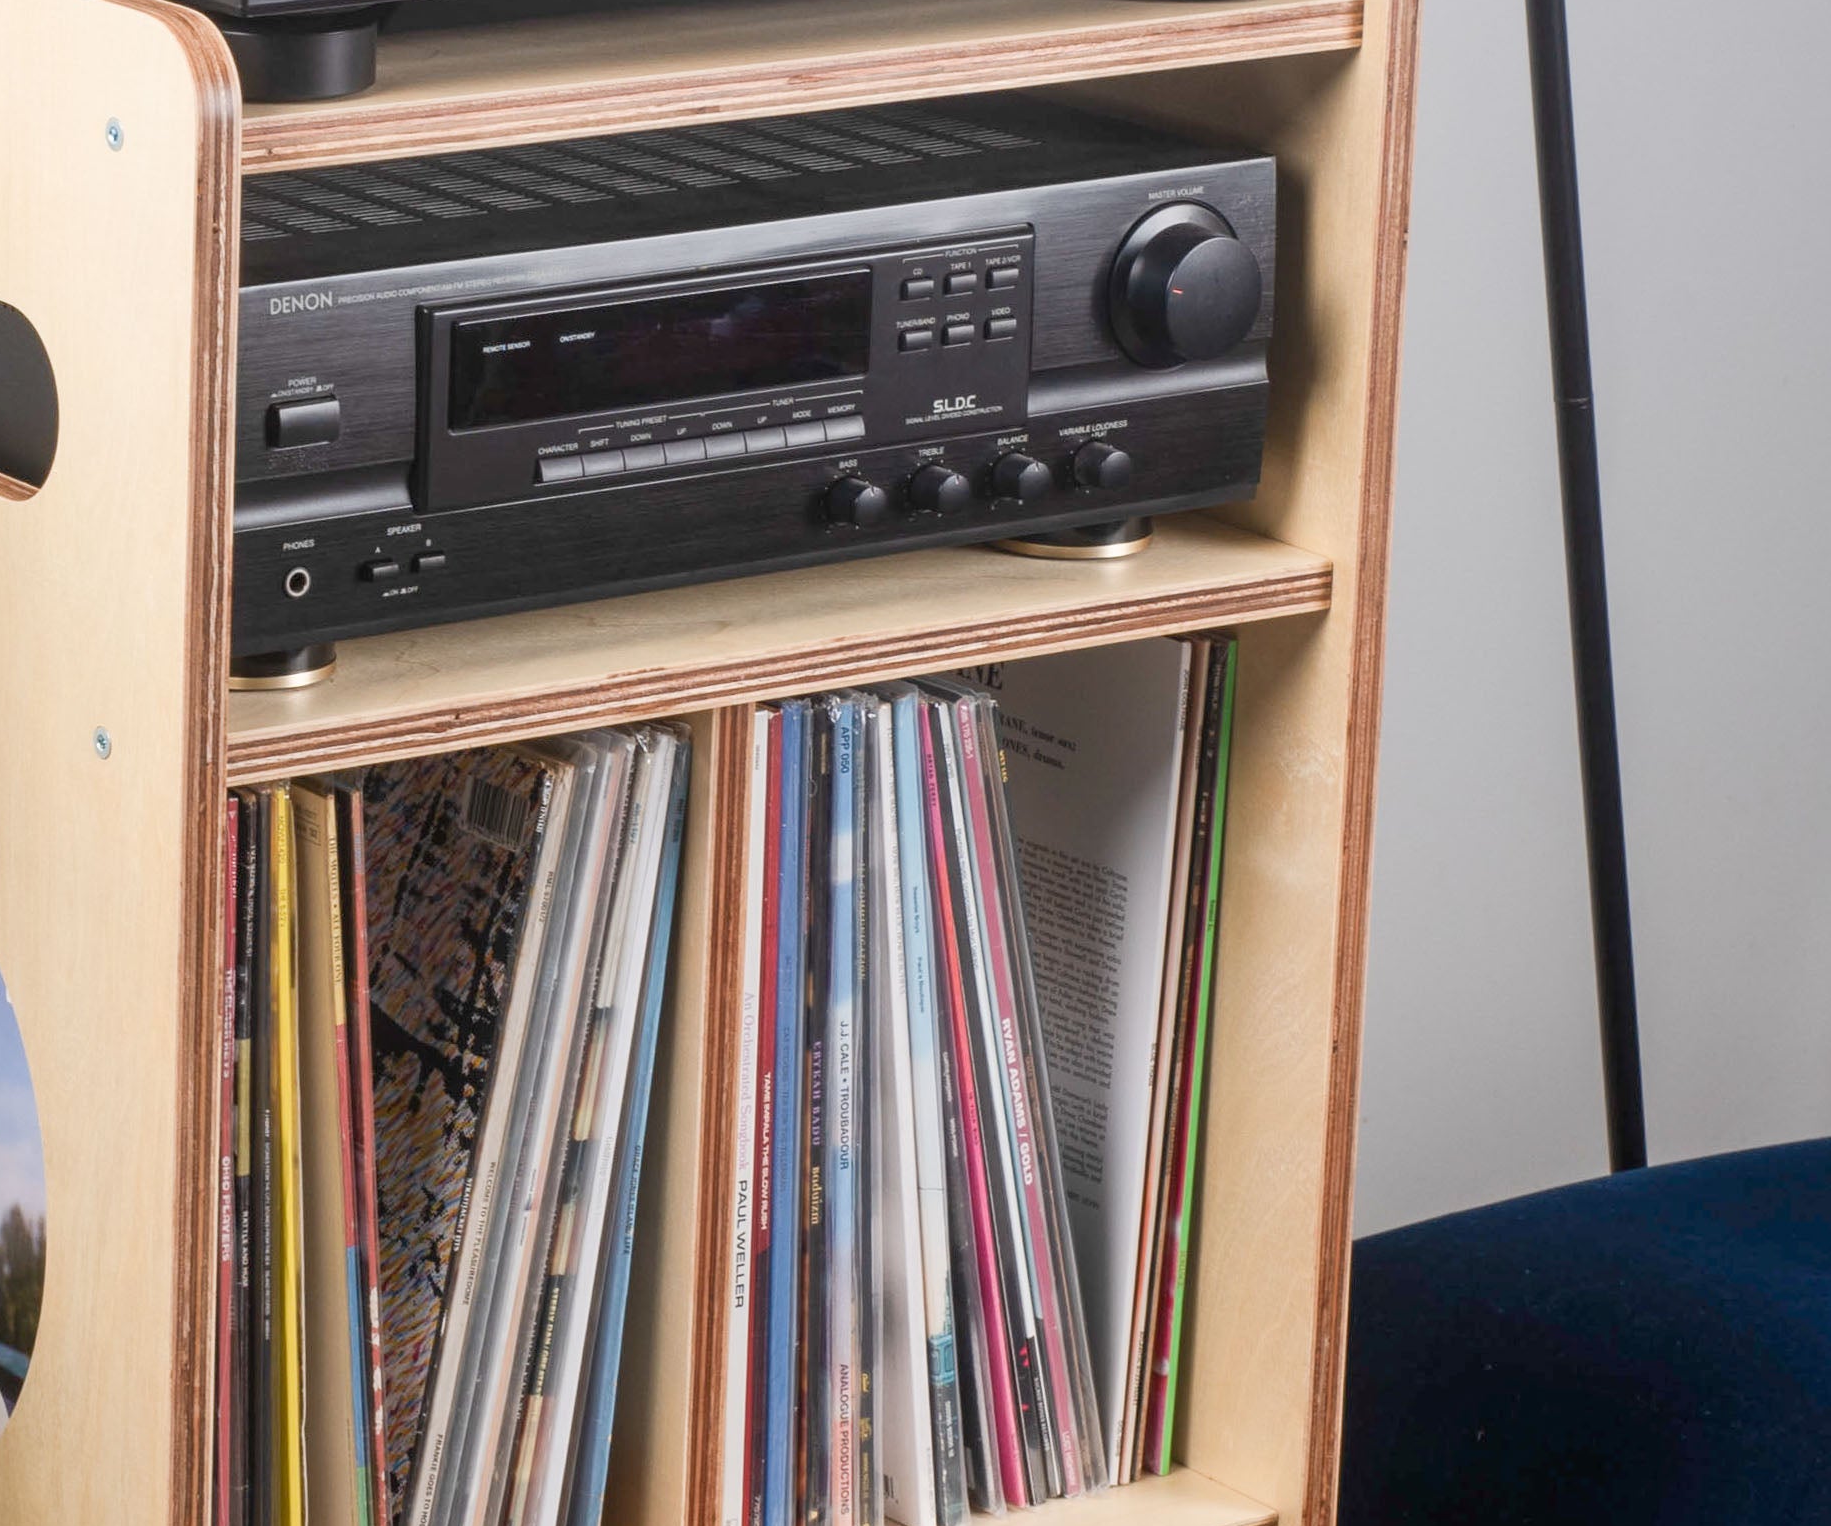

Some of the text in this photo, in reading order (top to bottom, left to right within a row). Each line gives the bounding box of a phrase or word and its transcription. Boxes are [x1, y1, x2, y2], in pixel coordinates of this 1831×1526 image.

[1148, 185, 1205, 200] MASTER VOLUME
[945, 247, 977, 258] FUNCTION
[950, 262, 967, 271] TAPE
[985, 257, 1001, 266] TAPE
[913, 267, 923, 276] CD
[270, 291, 333, 316] DENON
[946, 312, 970, 322] PHONO
[991, 306, 1011, 316] VIDEO
[482, 340, 531, 354] REMOTE SENSOR
[288, 376, 317, 388] POWER
[772, 396, 795, 408] TUNER
[827, 401, 856, 414] MEMORY
[757, 415, 768, 425] UP
[792, 408, 812, 420] MODE
[615, 414, 667, 429] TUNING PRESET
[712, 421, 734, 431] DOWN
[1058, 419, 1128, 438] VARIABLE LOUDNESS
[630, 431, 652, 443] DOWN
[677, 426, 687, 436] UP
[589, 437, 610, 449] SHIFT
[997, 433, 1029, 446] BALANCE
[538, 442, 580, 456] CHARACTER
[919, 445, 945, 457] TREBLE
[838, 458, 857, 470] BASS
[386, 523, 422, 536] SPEAKER
[282, 538, 315, 551] PHONES
[374, 546, 381, 554] A
[840, 726, 850, 774] APP 050
[998, 749, 1009, 783] WET LEG
[329, 836, 338, 857] THE
[330, 859, 340, 901] MOTELS
[225, 968, 234, 993] THE
[1001, 1017, 1016, 1064] RYAN
[737, 991, 755, 1171] An Orchestrated Songbook
[811, 1040, 823, 1146] ERYKAH BADU
[840, 1020, 850, 1170] J.J. CALE TROUBADOUR
[1008, 1067, 1027, 1129] ADAMS
[760, 1072, 771, 1230] TAME IMPALA THE SLOW RUSH
[1019, 1141, 1034, 1186] GOLD
[222, 1155, 233, 1263] OHIO PLAYERS
[462, 1161, 497, 1306] WELCOME TO THE PLEASUREDOME
[240, 1210, 250, 1288] RATTLE AND HUM
[734, 1179, 748, 1309] PAUL WELLER
[544, 1324, 554, 1345] DAN
[839, 1364, 851, 1515] ANALOGUE PRODUCTIONS
[429, 1434, 445, 1471] FRANKIE
[425, 1473, 438, 1497] GOES
[422, 1498, 433, 1511] TO
